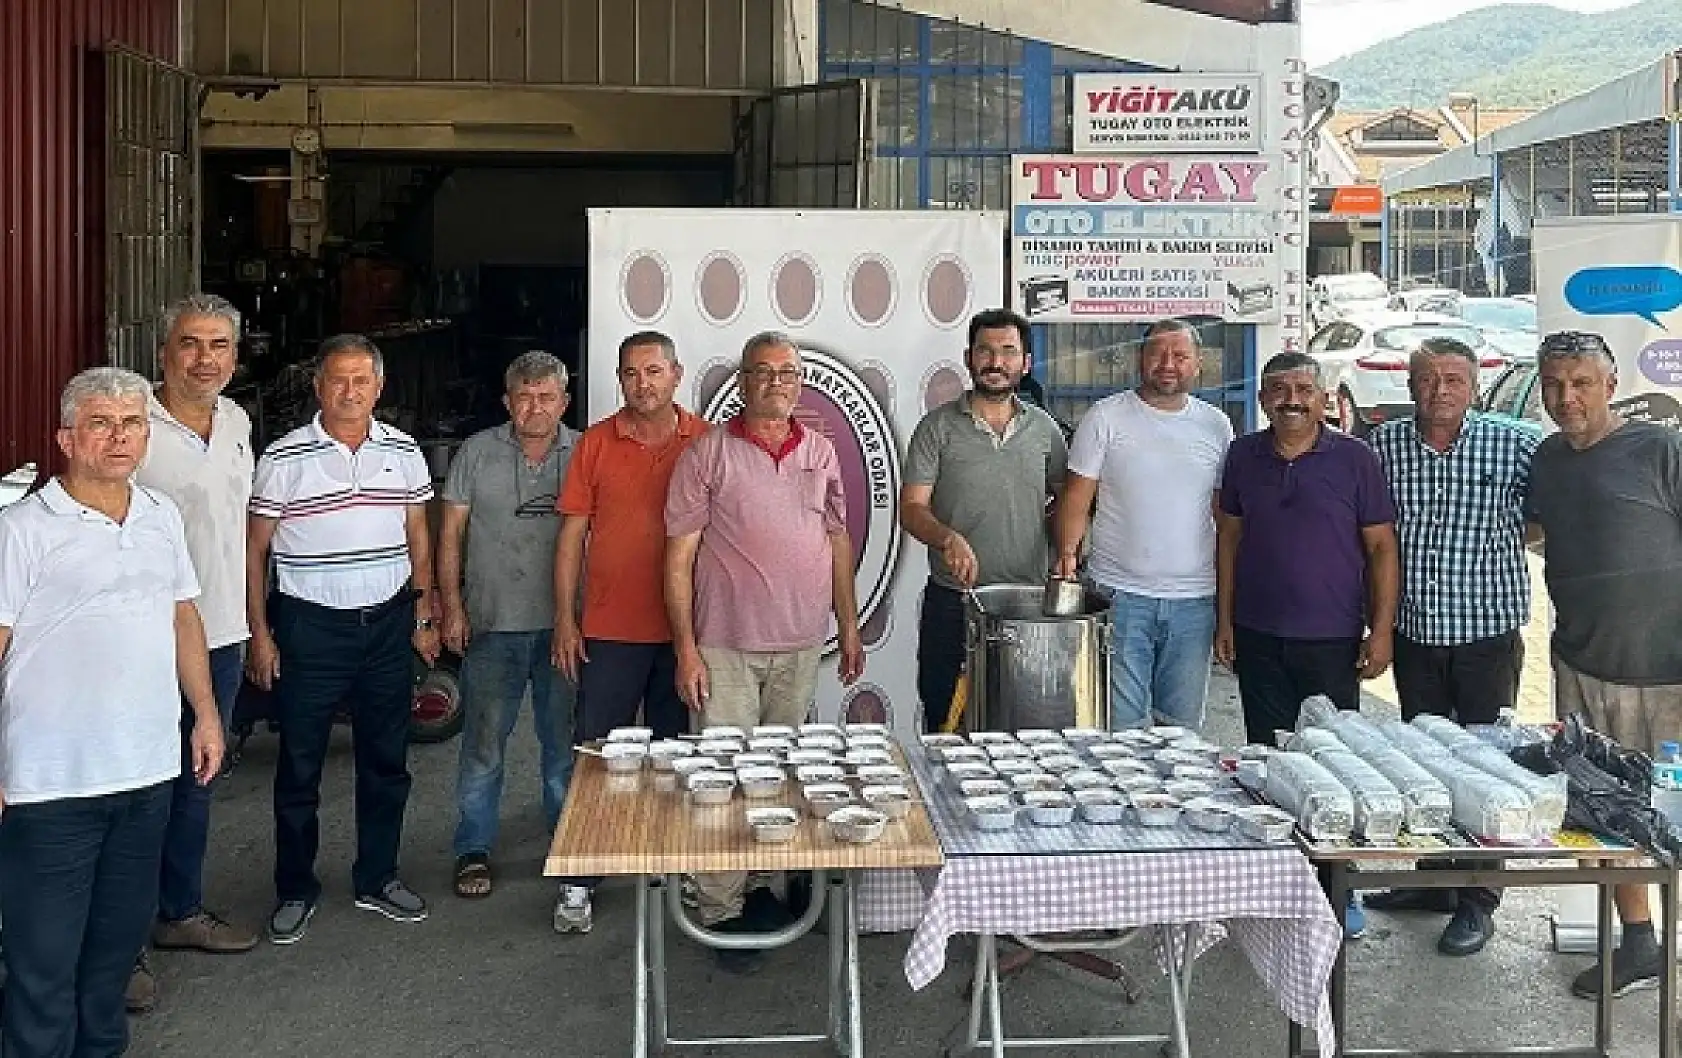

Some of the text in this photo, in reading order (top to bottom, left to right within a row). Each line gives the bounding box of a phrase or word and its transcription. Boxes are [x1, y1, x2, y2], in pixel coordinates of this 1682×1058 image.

[1089, 116, 1138, 131] TUGAY
[1143, 116, 1172, 130] OTO
[1022, 161, 1269, 203] TUGAY
[1024, 209, 1094, 234] OTO
[1023, 238, 1083, 253] DİNAMO
[1087, 238, 1141, 253] TAMİRİ
[1145, 240, 1157, 253] &
[1162, 240, 1212, 253] BAKIM
[1202, 269, 1223, 281] VE
[1087, 286, 1142, 298] BAKIM
